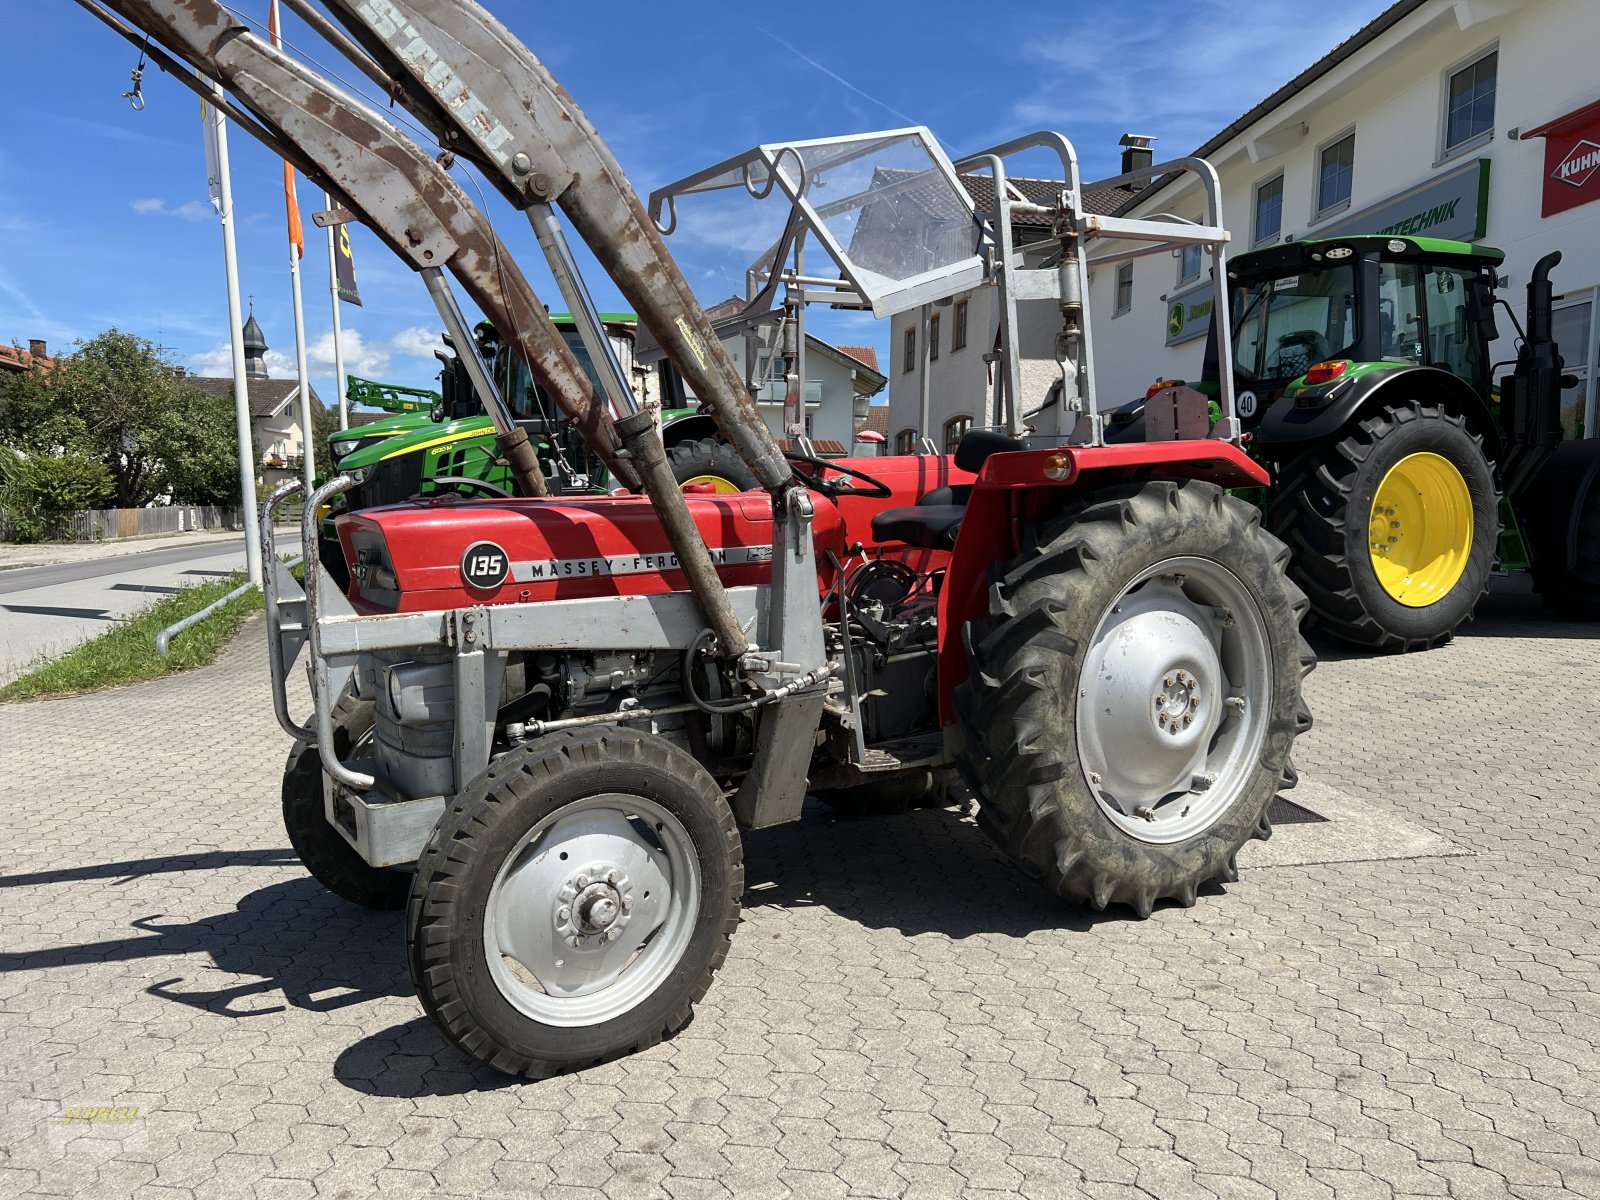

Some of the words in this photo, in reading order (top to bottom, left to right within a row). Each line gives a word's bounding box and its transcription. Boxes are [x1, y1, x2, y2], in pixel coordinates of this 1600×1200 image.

[1561, 149, 1600, 179] KUHN
[1240, 395, 1253, 414] 40
[470, 555, 503, 577] 135
